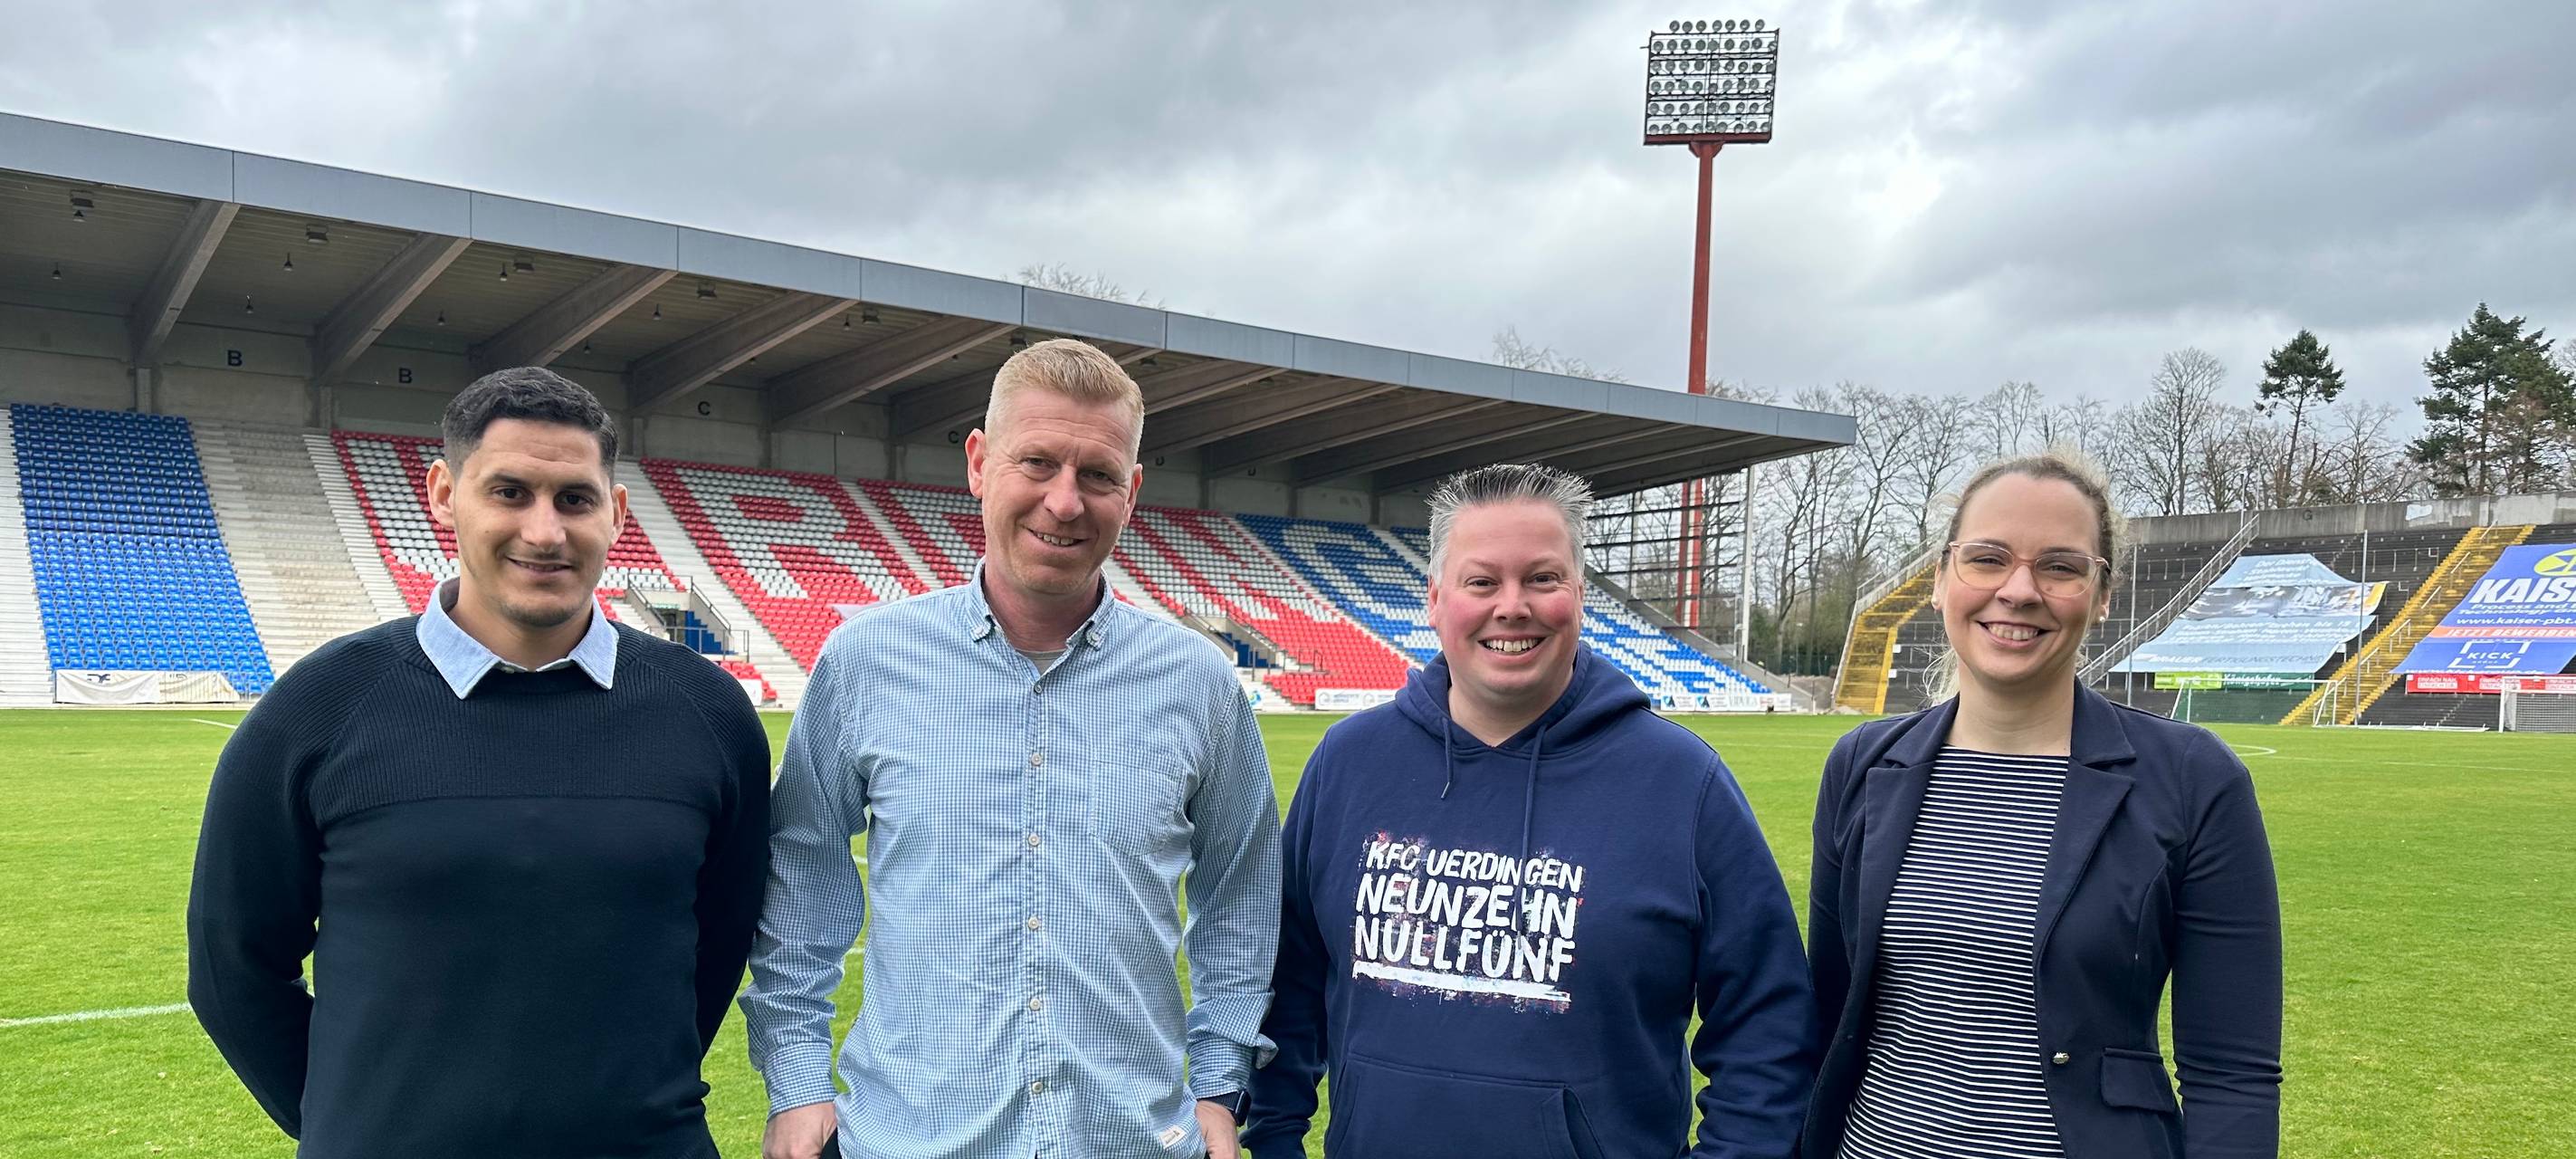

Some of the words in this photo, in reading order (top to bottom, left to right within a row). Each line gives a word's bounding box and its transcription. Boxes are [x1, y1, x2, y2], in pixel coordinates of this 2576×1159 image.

[227, 350, 243, 367] B
[398, 367, 413, 384] B
[698, 401, 711, 416] C
[2468, 578, 2576, 603] KAIS
[2457, 617, 2576, 625] www.kaiser-pbt.
[1365, 840, 1420, 870] KFC
[1426, 849, 1583, 893] UERDINGEN
[1356, 872, 1577, 939] NEUNZEHN
[1355, 915, 1576, 982] NULLFÜNF
